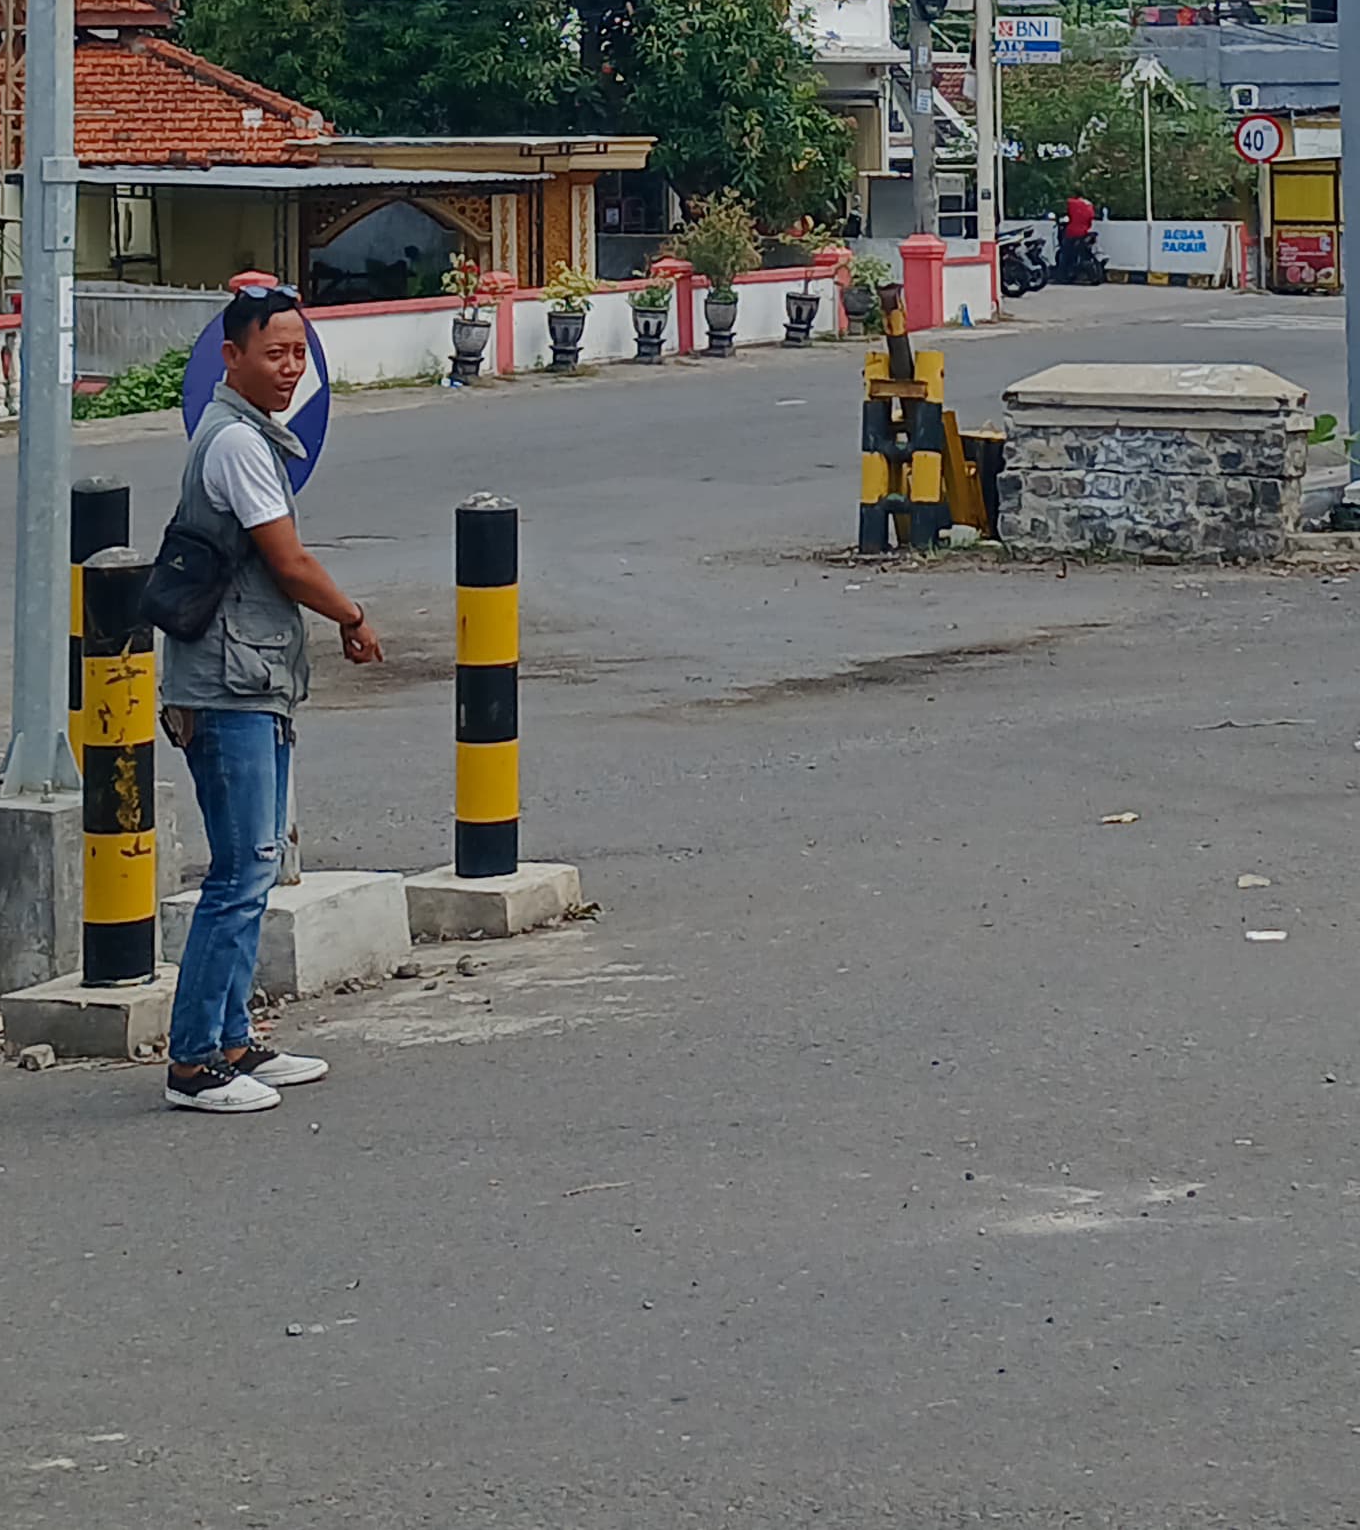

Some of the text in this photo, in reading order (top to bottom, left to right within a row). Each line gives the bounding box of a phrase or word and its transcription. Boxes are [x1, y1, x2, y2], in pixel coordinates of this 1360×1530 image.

[1016, 21, 1048, 37] BNI
[998, 41, 1025, 52] ATM
[1243, 129, 1264, 152] 40
